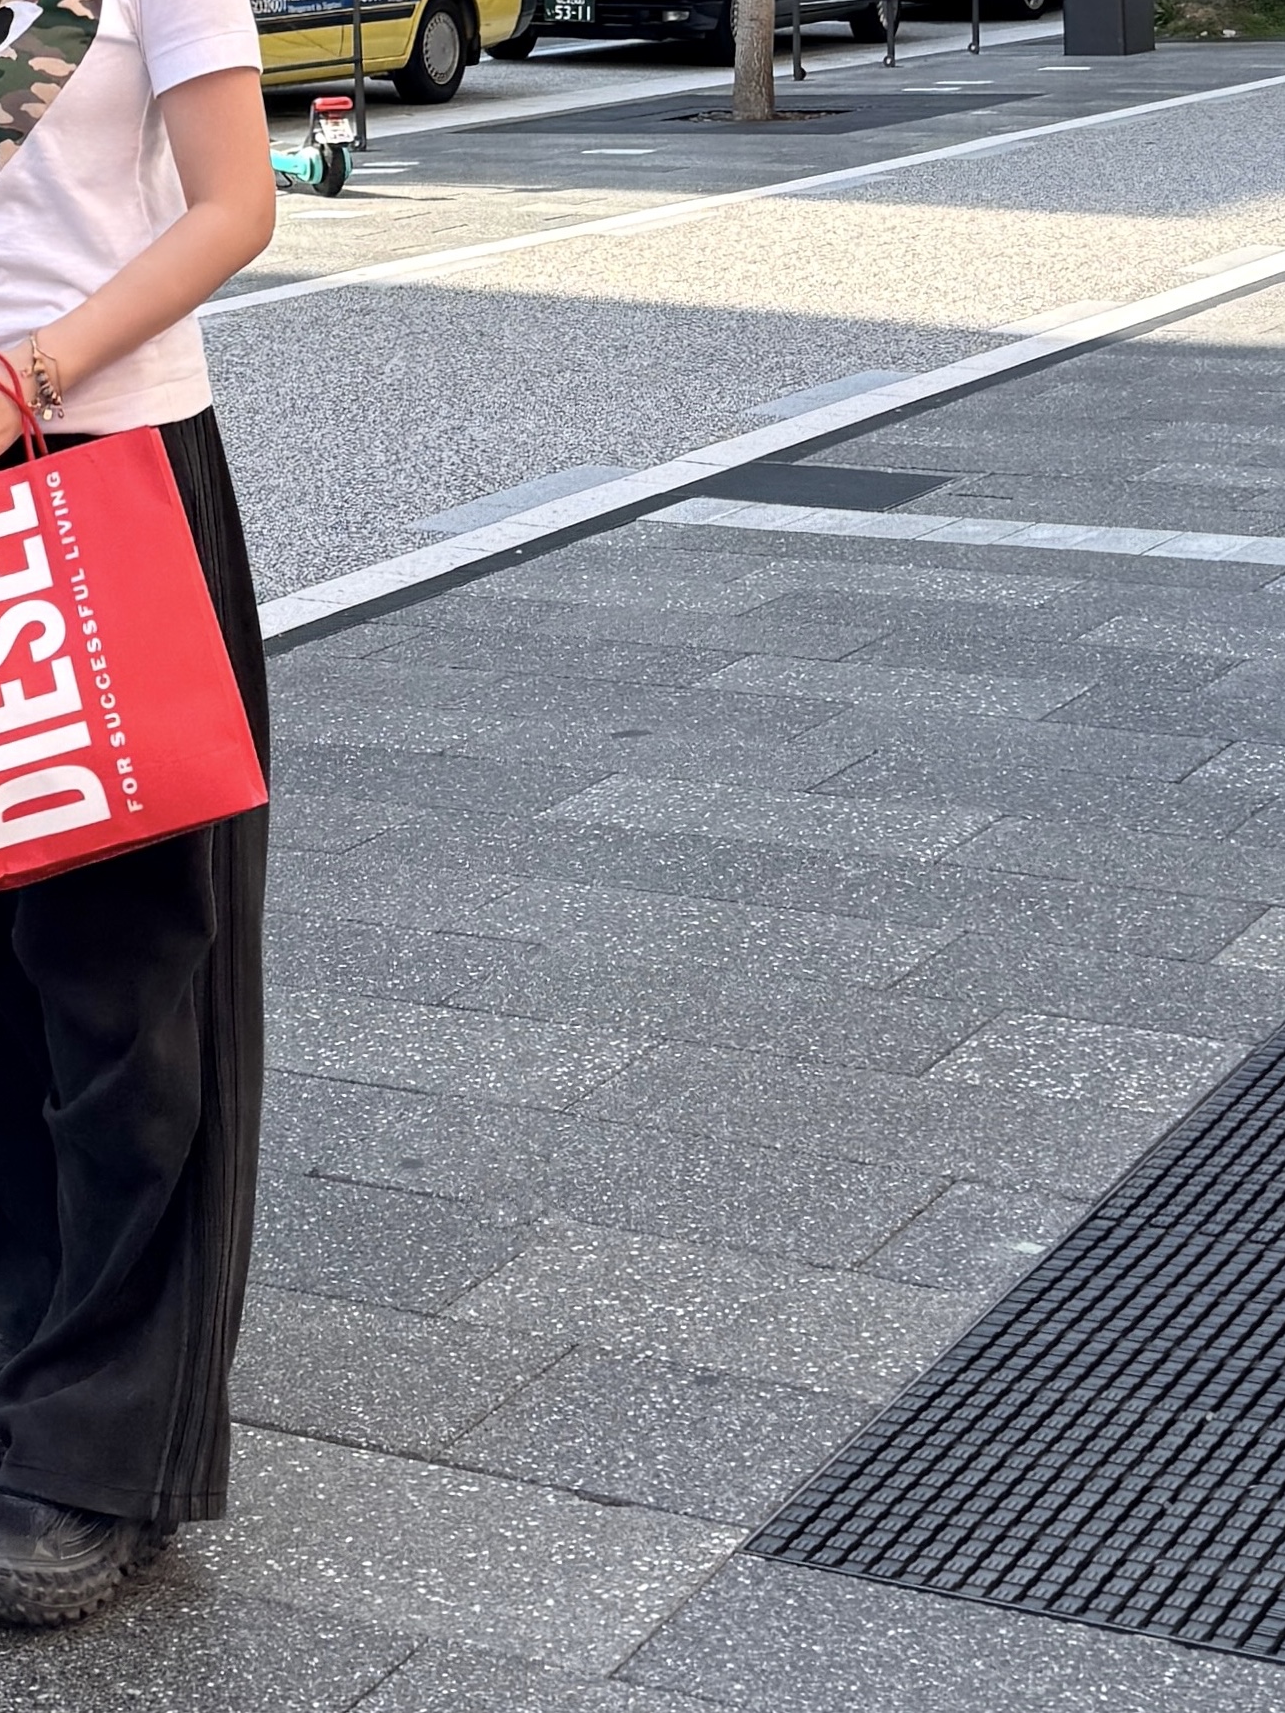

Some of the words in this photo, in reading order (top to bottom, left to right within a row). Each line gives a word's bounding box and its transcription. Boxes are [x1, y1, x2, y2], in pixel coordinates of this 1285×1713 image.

[554, 4, 591, 22] 53-11
[46, 470, 81, 560] LIVING
[71, 568, 126, 748] SUCCESSFUL
[115, 756, 144, 814] FOR
